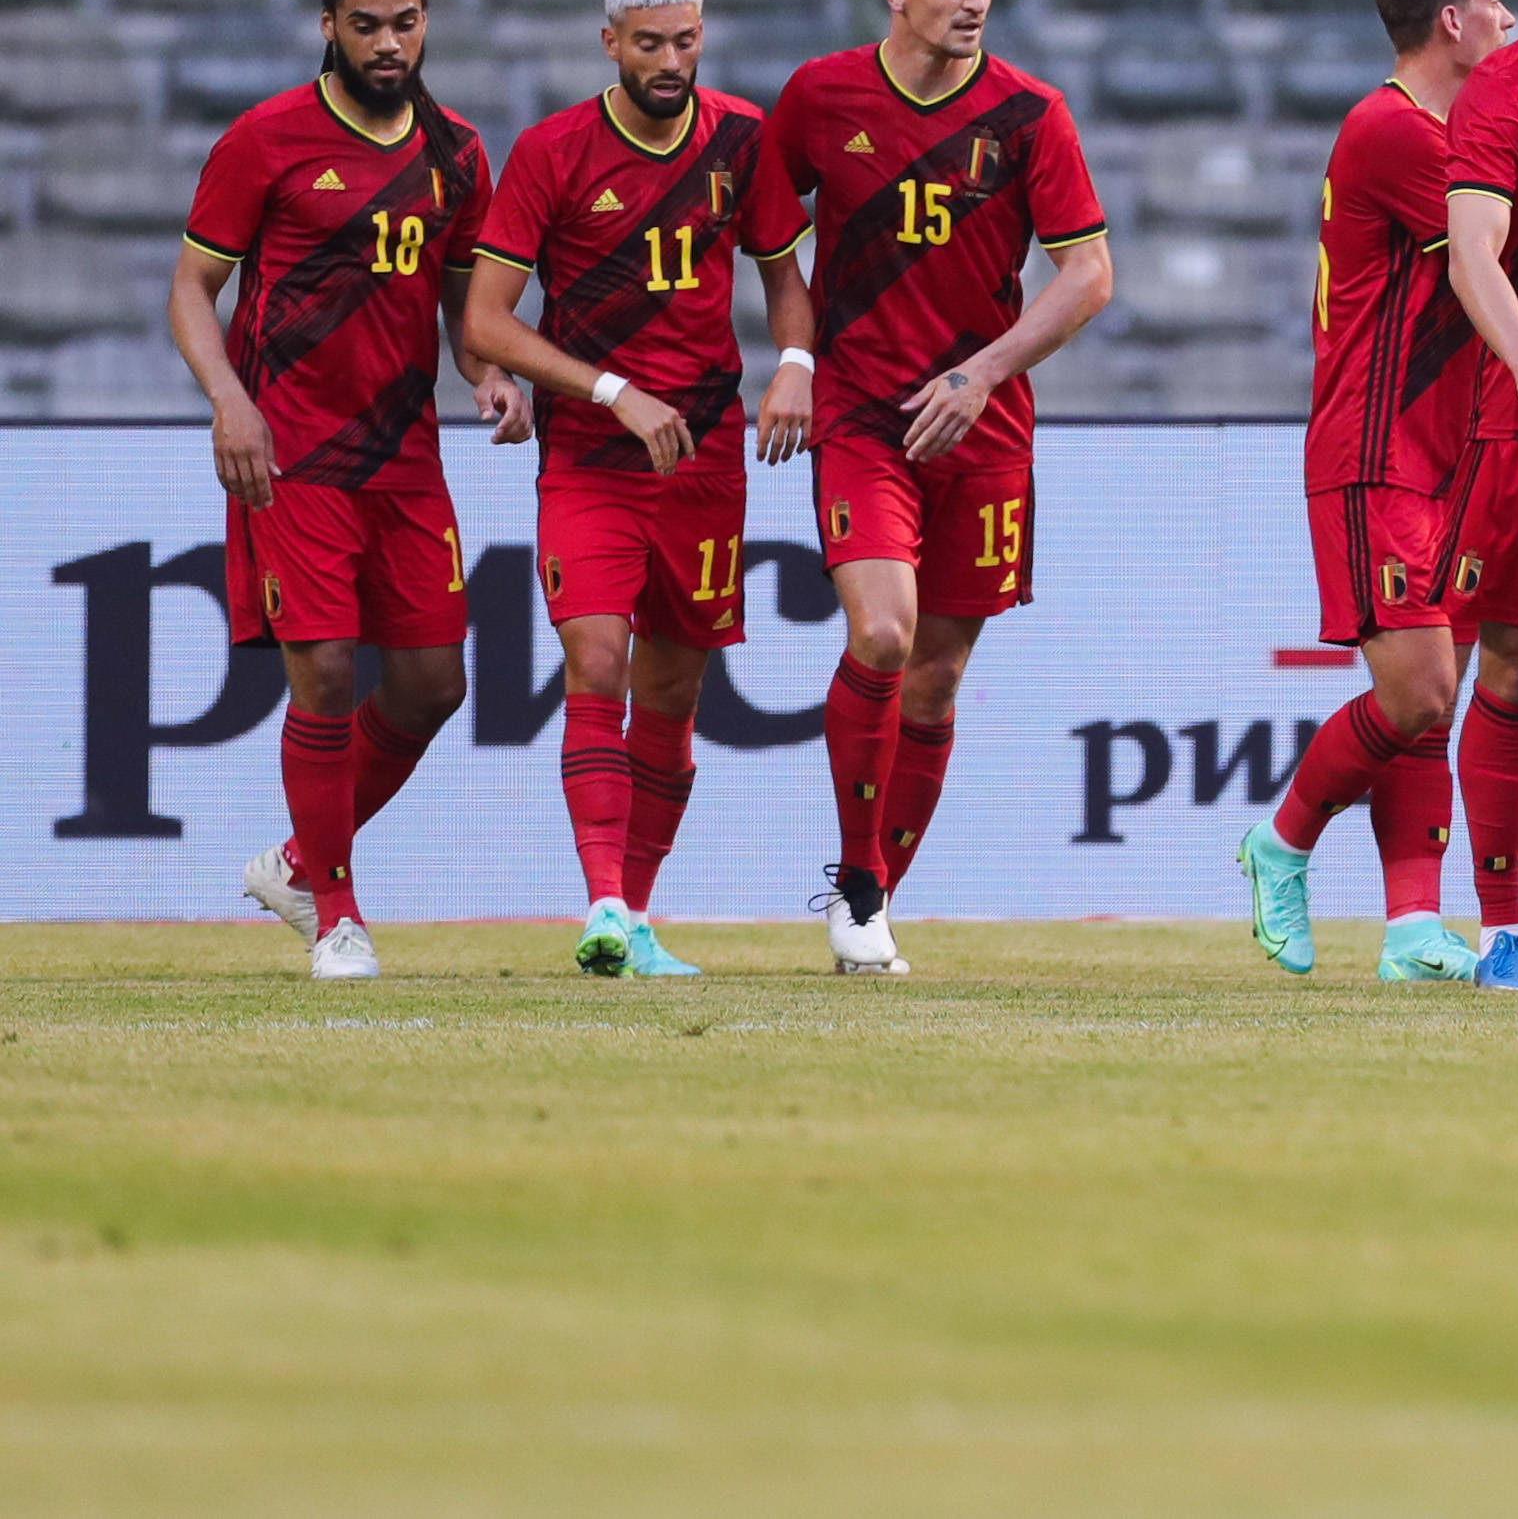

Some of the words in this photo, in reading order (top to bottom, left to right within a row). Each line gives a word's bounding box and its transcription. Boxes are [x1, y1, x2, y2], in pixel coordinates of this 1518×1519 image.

[371, 210, 424, 276] 18
[896, 178, 952, 246] 15
[644, 225, 700, 292] 11
[974, 497, 1021, 568] 15
[692, 534, 740, 601] 11
